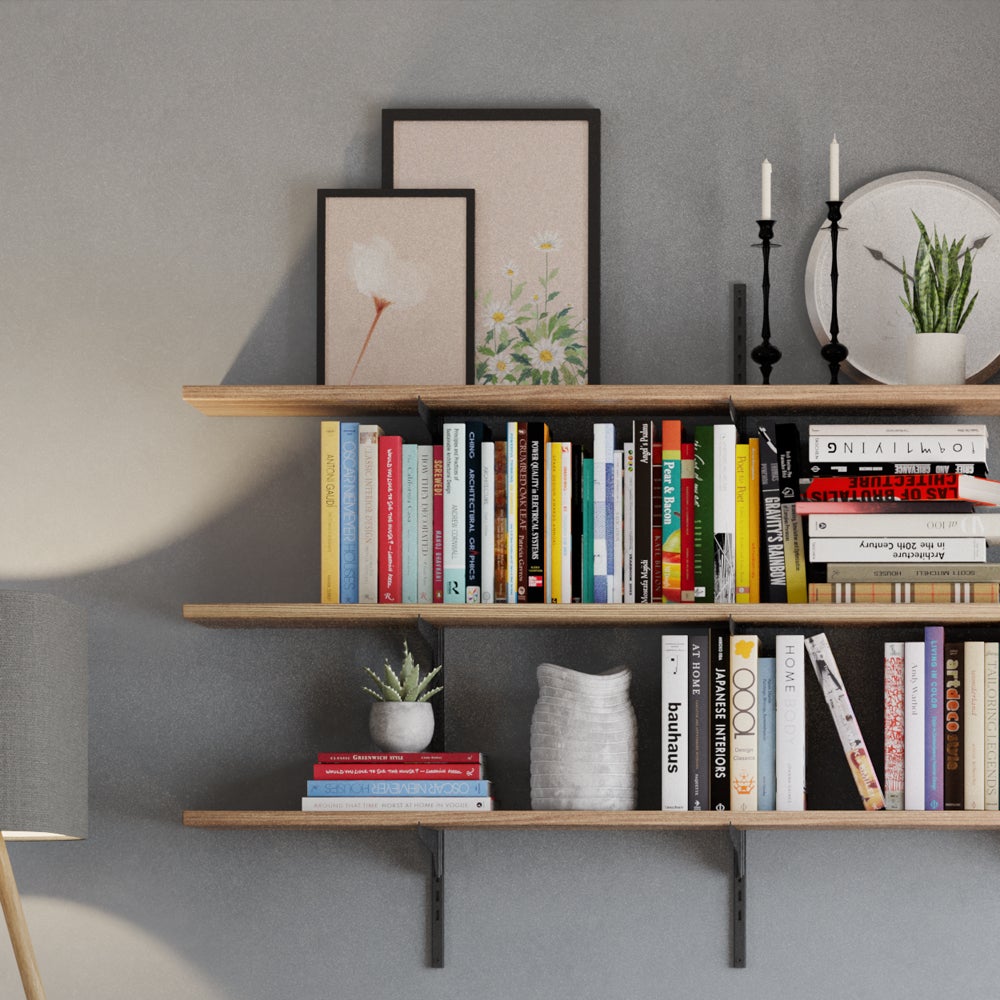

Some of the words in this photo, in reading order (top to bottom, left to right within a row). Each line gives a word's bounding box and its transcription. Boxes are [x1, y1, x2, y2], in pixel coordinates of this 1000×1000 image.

[469, 431, 477, 459] CHING
[639, 423, 648, 443] Psalms
[343, 441, 356, 482] OSCAR
[519, 439, 528, 486] CRUMBLED
[531, 440, 539, 461] POWER
[326, 454, 335, 483] ANTONI
[421, 454, 431, 475] HOW
[531, 462, 539, 488] QUALITY
[664, 461, 676, 485] Pear
[737, 456, 748, 474] Poet
[894, 463, 932, 475] GRIEVANCE
[936, 463, 950, 475] AND
[955, 463, 975, 475] GRIEF
[421, 477, 431, 500] THEY
[434, 459, 444, 496] SCREWED!
[364, 478, 374, 513] INTERIOR
[469, 468, 477, 533] ARCHITECTURAL
[519, 487, 528, 506] OAK
[664, 486, 676, 494] &
[737, 486, 748, 504] Poet
[900, 487, 922, 500] OF
[519, 508, 528, 531] LEAF
[531, 494, 539, 532] ELECTRICAL
[664, 496, 676, 525] Bacon
[766, 496, 784, 542] GRAVITY'S
[364, 515, 374, 543] DESIGN
[421, 503, 431, 557] DECORATED
[518, 535, 526, 558] Patricia
[531, 532, 539, 560] SYSTEMS
[859, 541, 894, 550] Century
[892, 552, 946, 560] Architecture
[896, 541, 917, 550] 20th
[919, 541, 934, 550] the
[936, 541, 946, 550] in
[343, 544, 356, 590] HOUSES
[769, 544, 787, 586] RAINBOW
[692, 643, 700, 658] AT
[692, 662, 700, 696] HOME
[785, 645, 796, 693] HOME
[909, 663, 918, 684] Andy
[931, 670, 938, 679] IN
[715, 667, 726, 719] JAPANESE
[909, 686, 918, 716] Warhol
[987, 661, 997, 731] TAILORING
[668, 702, 682, 774] bauhaus
[715, 723, 726, 779] INTERIORS
[987, 735, 997, 796] LEGENDS
[324, 782, 370, 794] HOUSES
[427, 782, 471, 794] OSCAR
